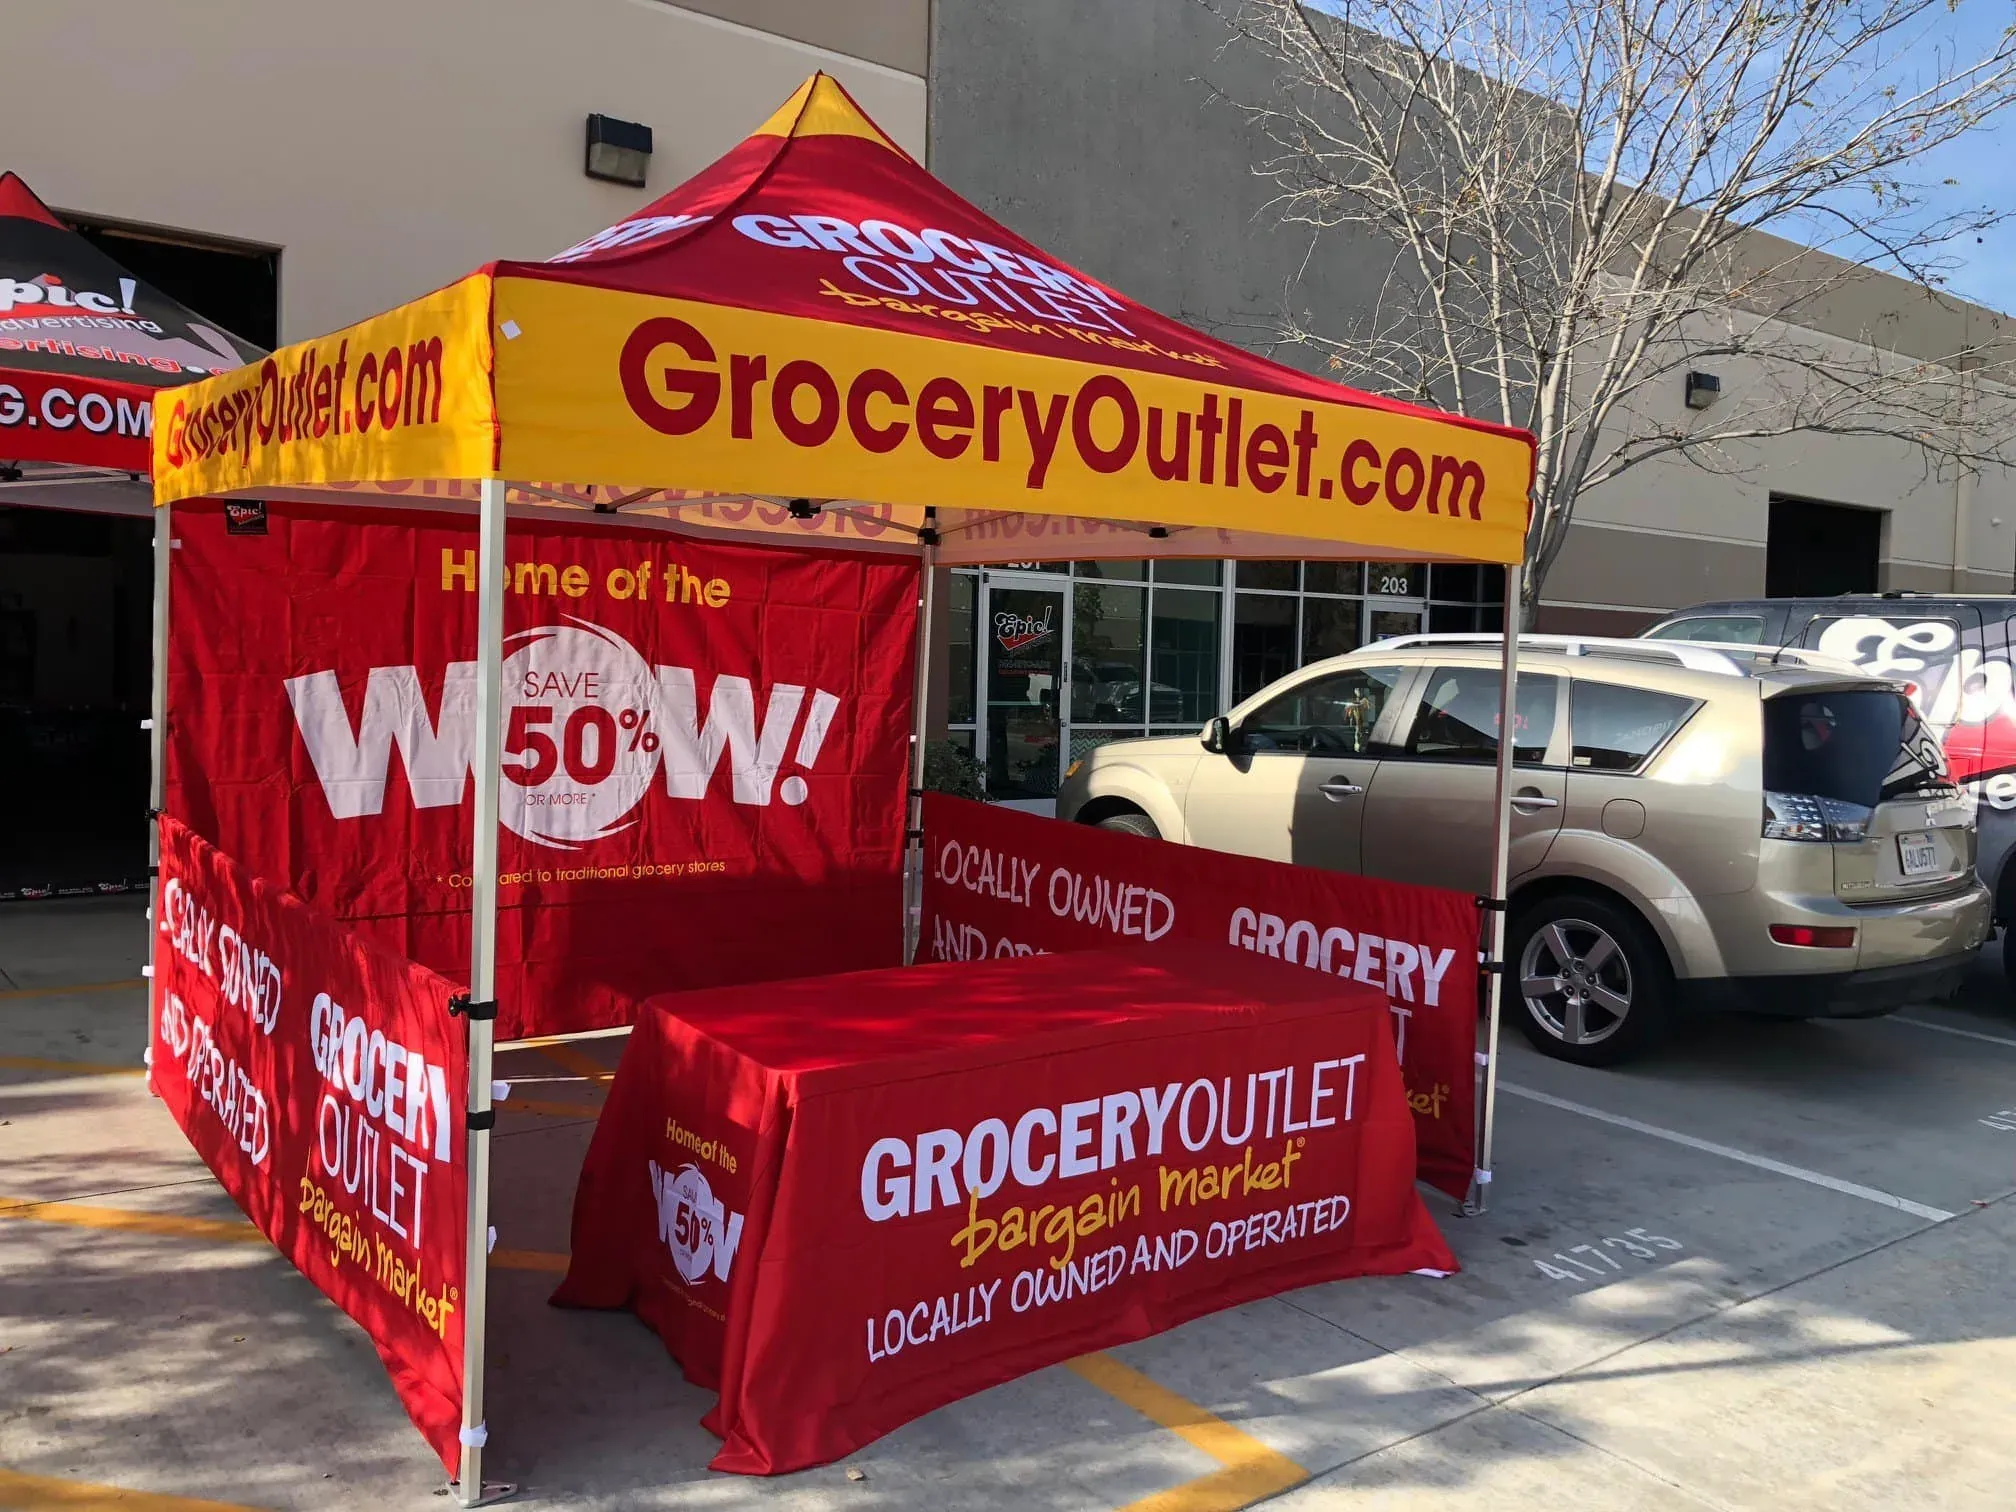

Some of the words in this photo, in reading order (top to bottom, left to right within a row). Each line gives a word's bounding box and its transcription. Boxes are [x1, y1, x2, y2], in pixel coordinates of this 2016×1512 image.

[732, 214, 1127, 311] GROCERY
[842, 255, 1136, 336] OUTLET
[819, 278, 1064, 340] bargain
[166, 336, 442, 469] GroceryOutlet.com
[619, 316, 1486, 521] GroceryOutlet.com
[442, 548, 590, 597] Hme
[607, 561, 652, 600] of
[664, 564, 731, 608] the
[1381, 576, 1408, 594] 203
[995, 606, 1053, 642] Epic!
[523, 671, 599, 699] SAVE
[501, 705, 659, 786] 50%
[526, 794, 545, 806] OR
[549, 793, 587, 805] MORE
[449, 868, 532, 888] Coared
[537, 867, 551, 883] to
[556, 863, 628, 881] traditional
[632, 861, 684, 879] grocery
[688, 860, 725, 873] stores
[1049, 868, 1175, 941] OWNED
[1229, 907, 1456, 1007] GROCERY
[311, 992, 450, 1163] GROCERY
[320, 1095, 427, 1249] OUTLET
[719, 1144, 737, 1174] the
[300, 1146, 370, 1272] bargain
[950, 1176, 1141, 1269] bargain
[867, 1278, 1001, 1363] LOCALLY
[1010, 1245, 1126, 1313] OWNED
[1130, 1223, 1198, 1274] AND
[1206, 1195, 1350, 1260] OPERATED
[1533, 1228, 1683, 1281] 41735
